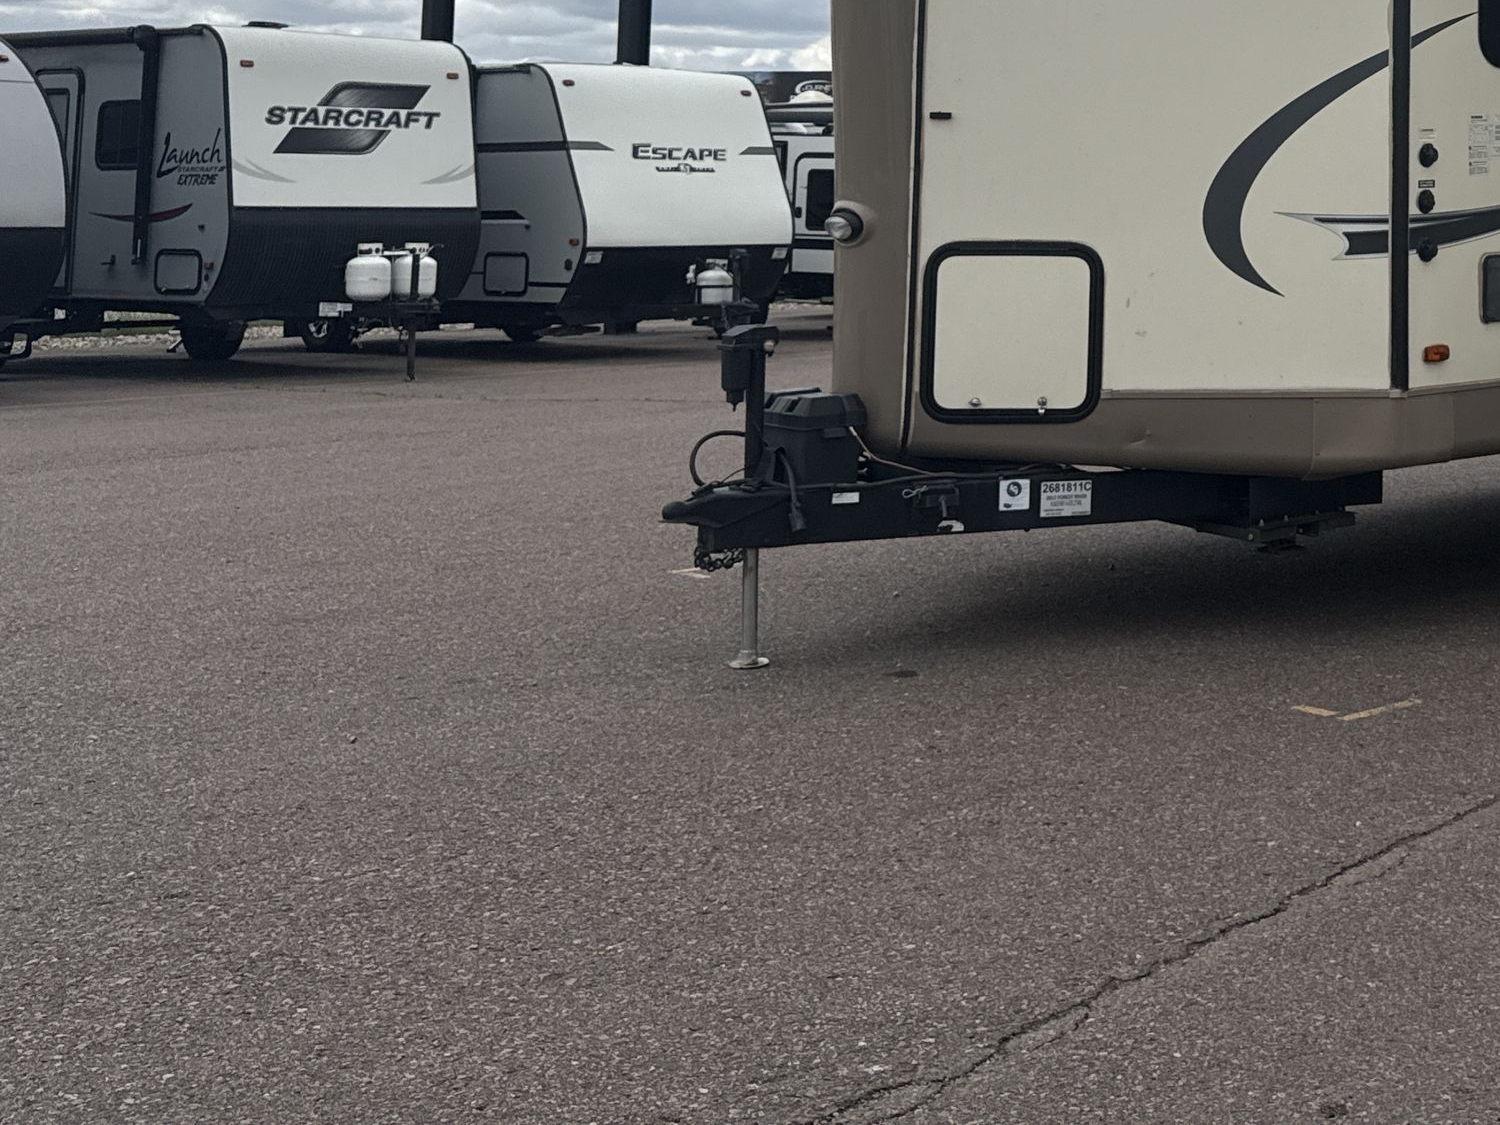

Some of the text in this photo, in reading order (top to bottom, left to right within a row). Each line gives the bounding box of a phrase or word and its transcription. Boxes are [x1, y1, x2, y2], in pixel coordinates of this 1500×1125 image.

[265, 106, 440, 130] STARCRAFT
[156, 128, 222, 178] Launch
[632, 143, 727, 161] ESCAPE
[177, 174, 219, 186] EXTREME
[1042, 481, 1091, 493] 2681811C
